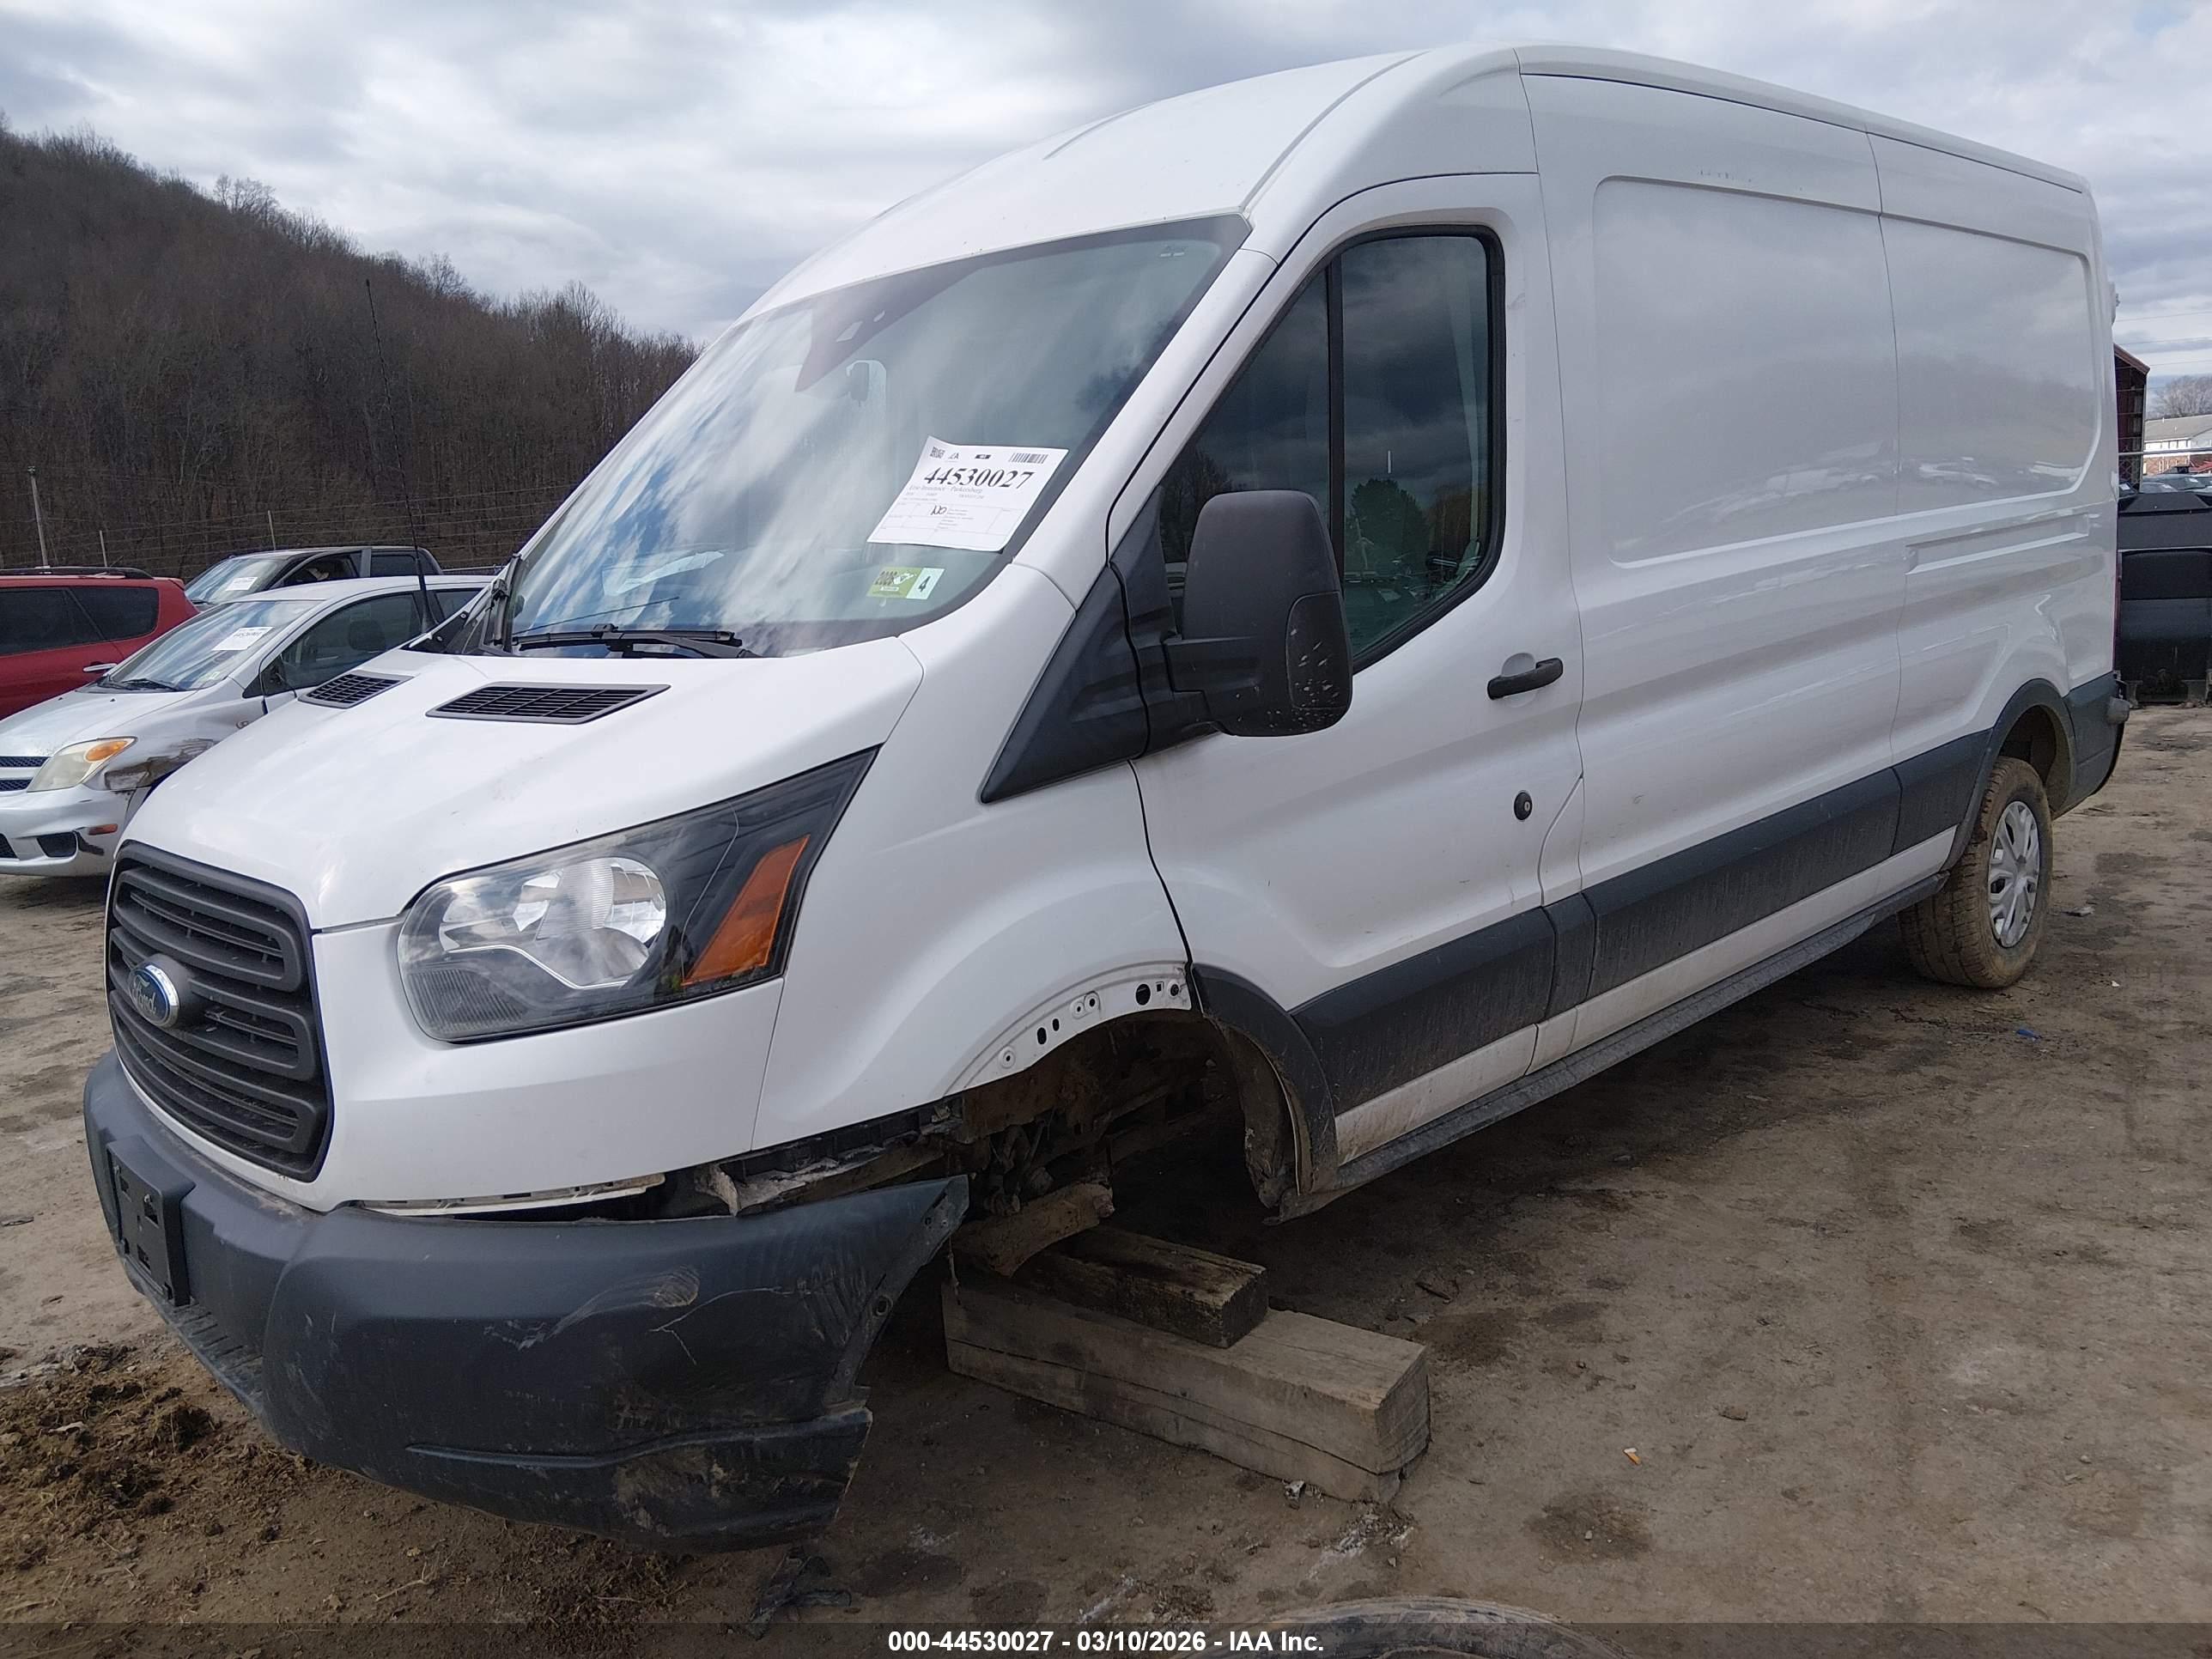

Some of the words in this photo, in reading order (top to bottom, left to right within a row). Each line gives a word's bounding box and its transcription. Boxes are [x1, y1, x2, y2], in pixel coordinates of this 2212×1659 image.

[924, 467, 1035, 489] 44530027
[918, 575, 931, 592] 4
[132, 974, 156, 1015] Ford
